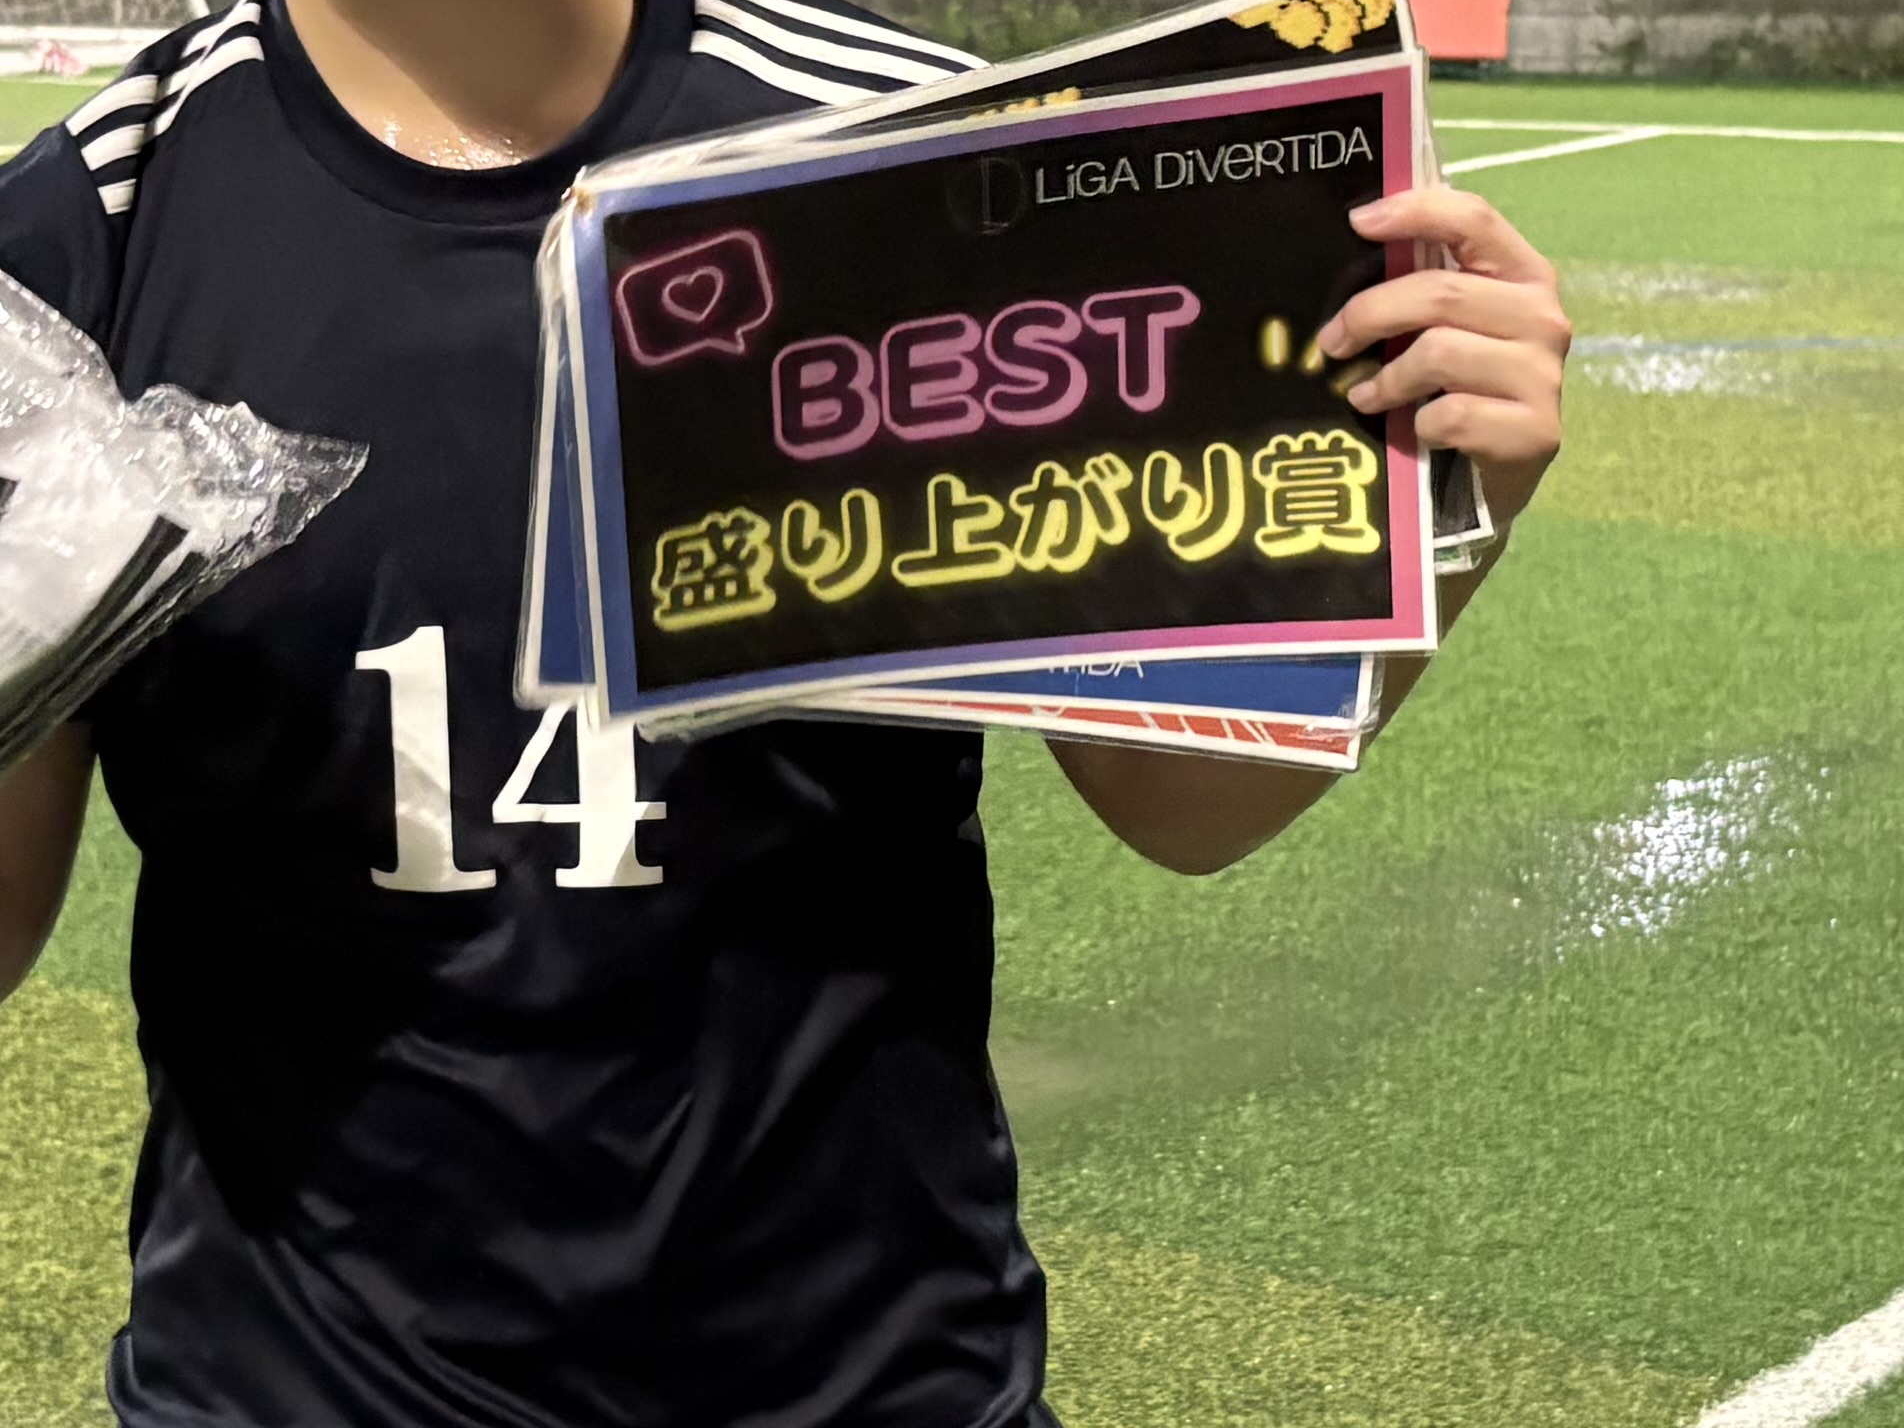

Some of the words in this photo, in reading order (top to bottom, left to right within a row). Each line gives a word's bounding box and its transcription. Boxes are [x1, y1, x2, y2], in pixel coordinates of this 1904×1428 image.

[772, 284, 1201, 461] BEST
[652, 429, 1382, 633] 盛り上がり賞
[355, 624, 667, 893] 14
